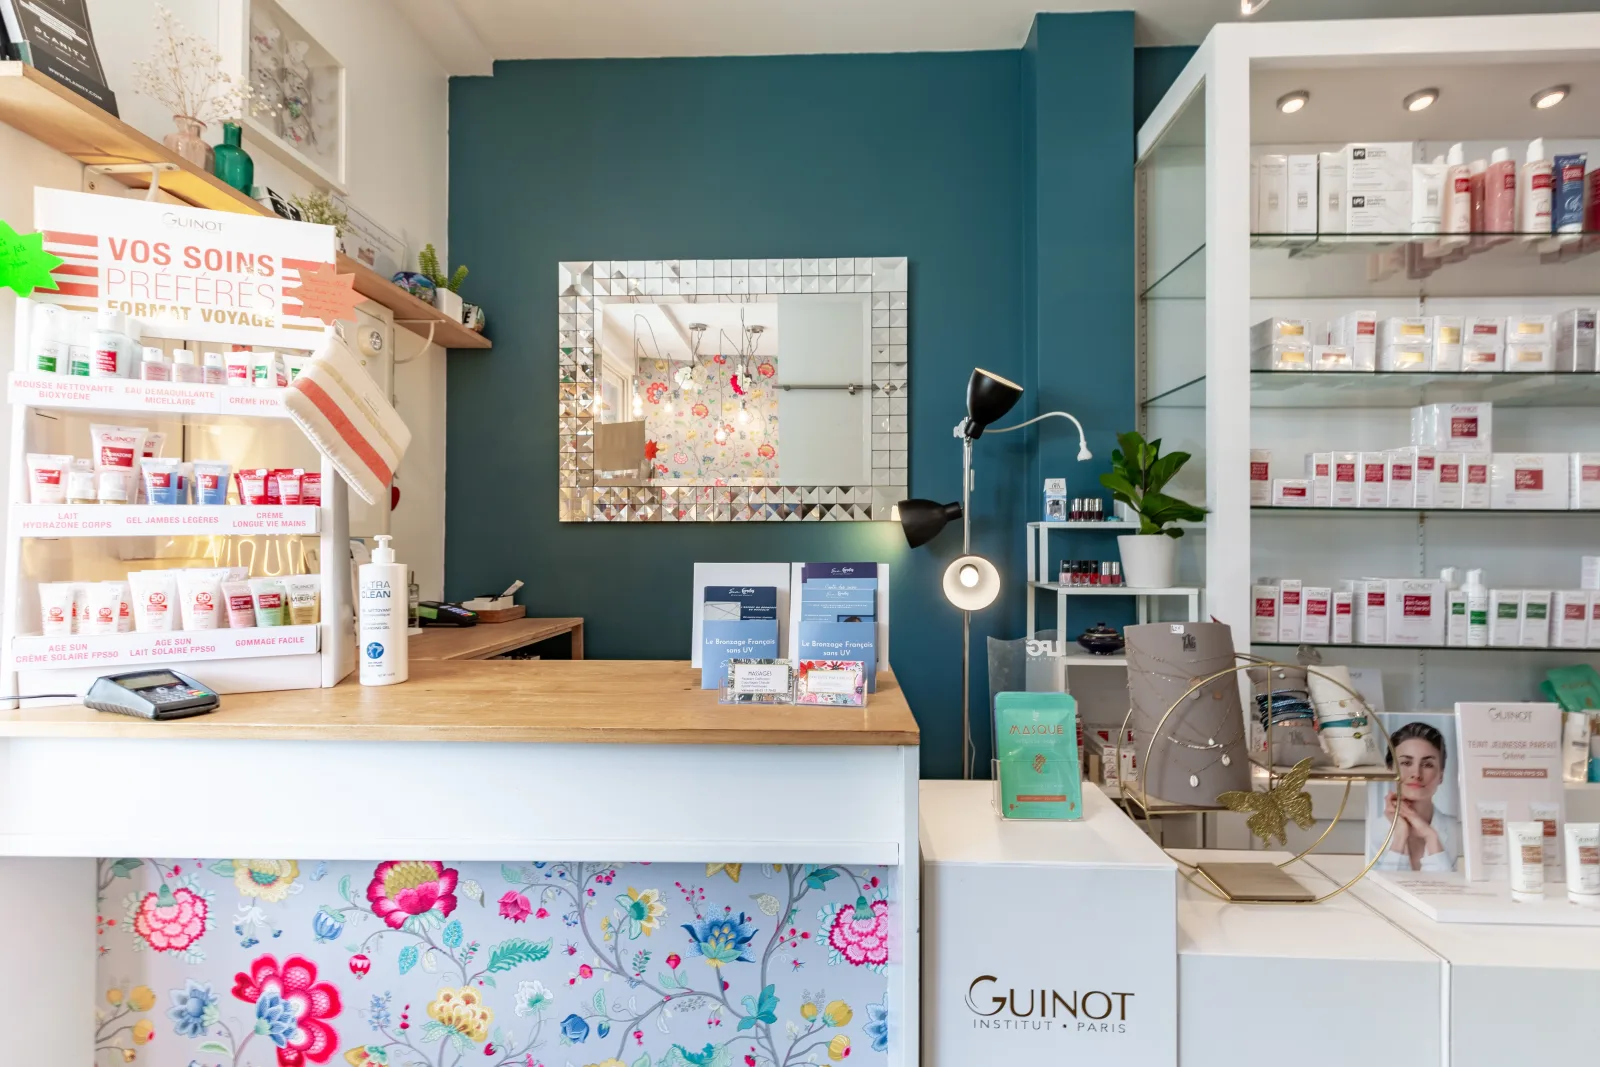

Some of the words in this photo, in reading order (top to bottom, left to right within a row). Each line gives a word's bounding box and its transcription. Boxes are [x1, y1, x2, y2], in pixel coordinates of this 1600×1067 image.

[33, 25, 87, 61] PLANITY
[162, 212, 225, 231] GUINOT
[108, 236, 171, 266] VOS
[183, 246, 275, 277] SOINS
[107, 267, 275, 309] PRÉFÉRÉS
[107, 299, 191, 320] FORMAT
[201, 308, 274, 328] VOYAGE
[14, 380, 53, 390] MOUSSE
[56, 382, 115, 393] NETTOYANTE
[125, 386, 142, 395] EAU
[144, 396, 197, 406] MICELLAIRE
[57, 512, 79, 520] LAIT
[126, 516, 143, 524] GEL
[145, 516, 180, 524] JAMBES
[22, 521, 79, 529] HYDRAZONE
[81, 521, 113, 529] CORPS
[232, 520, 264, 528] LONGUE
[281, 519, 307, 527] MAINS
[151, 593, 165, 601] 50
[197, 593, 210, 601] 50
[361, 590, 391, 599] CLEAN
[235, 637, 276, 647] GOMMAGE
[278, 636, 305, 644] FACILE
[715, 638, 746, 648] Bronzage
[749, 638, 776, 647] Français
[811, 641, 843, 650] Bronzage
[845, 641, 873, 650] Français
[69, 643, 88, 651] SUN
[129, 648, 149, 656] LAIT
[151, 646, 188, 655] SOLAIRE
[190, 645, 216, 653] FPS50
[742, 646, 754, 654] UV
[50, 652, 89, 661] SOLAIRE
[91, 650, 119, 659] FPS50
[1488, 707, 1533, 720] GUINOT
[1009, 724, 1064, 735] MASQUE
[1467, 740, 1488, 749] TEINT
[1490, 740, 1527, 749] JEUNESSE
[964, 974, 1135, 1021] GUINOT
[972, 1019, 1053, 1031] INSTITUT
[1076, 1022, 1127, 1034] PARIS
